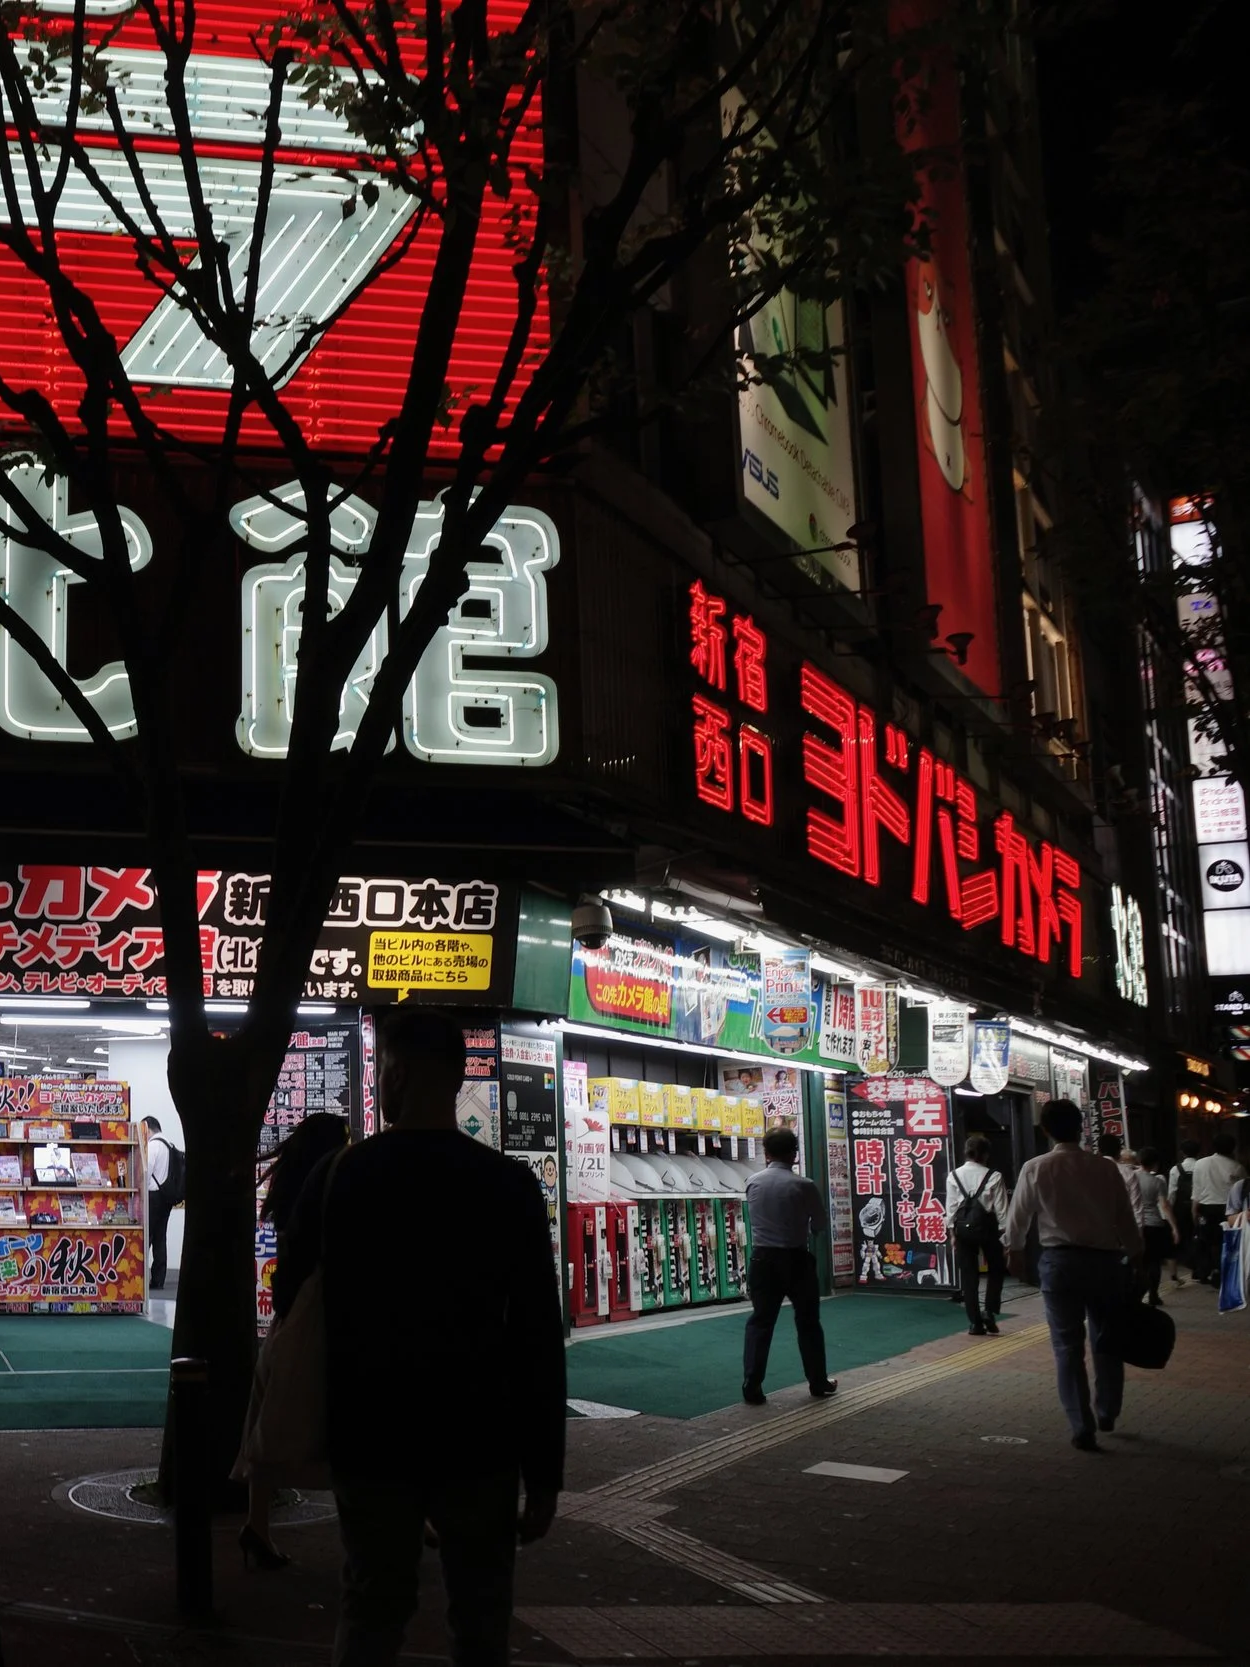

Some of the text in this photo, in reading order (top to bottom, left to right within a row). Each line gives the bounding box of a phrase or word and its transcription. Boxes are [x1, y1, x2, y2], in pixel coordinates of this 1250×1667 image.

[689, 578, 768, 714] 新宿
[692, 692, 774, 827] 西口
[800, 660, 1083, 979] ヨドバシカメラ
[374, 938, 473, 953] 当ビル内の各階や、
[373, 953, 489, 969] 他のビルにある売場の
[371, 969, 468, 984] 取扱商品はこちら
[765, 967, 796, 981] Enjoy
[762, 1093, 800, 1106] プリント
[867, 1079, 939, 1101] 交差点を
[763, 1103, 798, 1117] しよう!
[908, 1100, 943, 1132] 左
[544, 1135, 556, 1147] VISA
[854, 1138, 889, 1196] 時計
[893, 1138, 916, 1243] おもちゃ・ホビー
[912, 1138, 948, 1244] ゲーム機
[41, 1285, 99, 1296] 新宿西口本店
